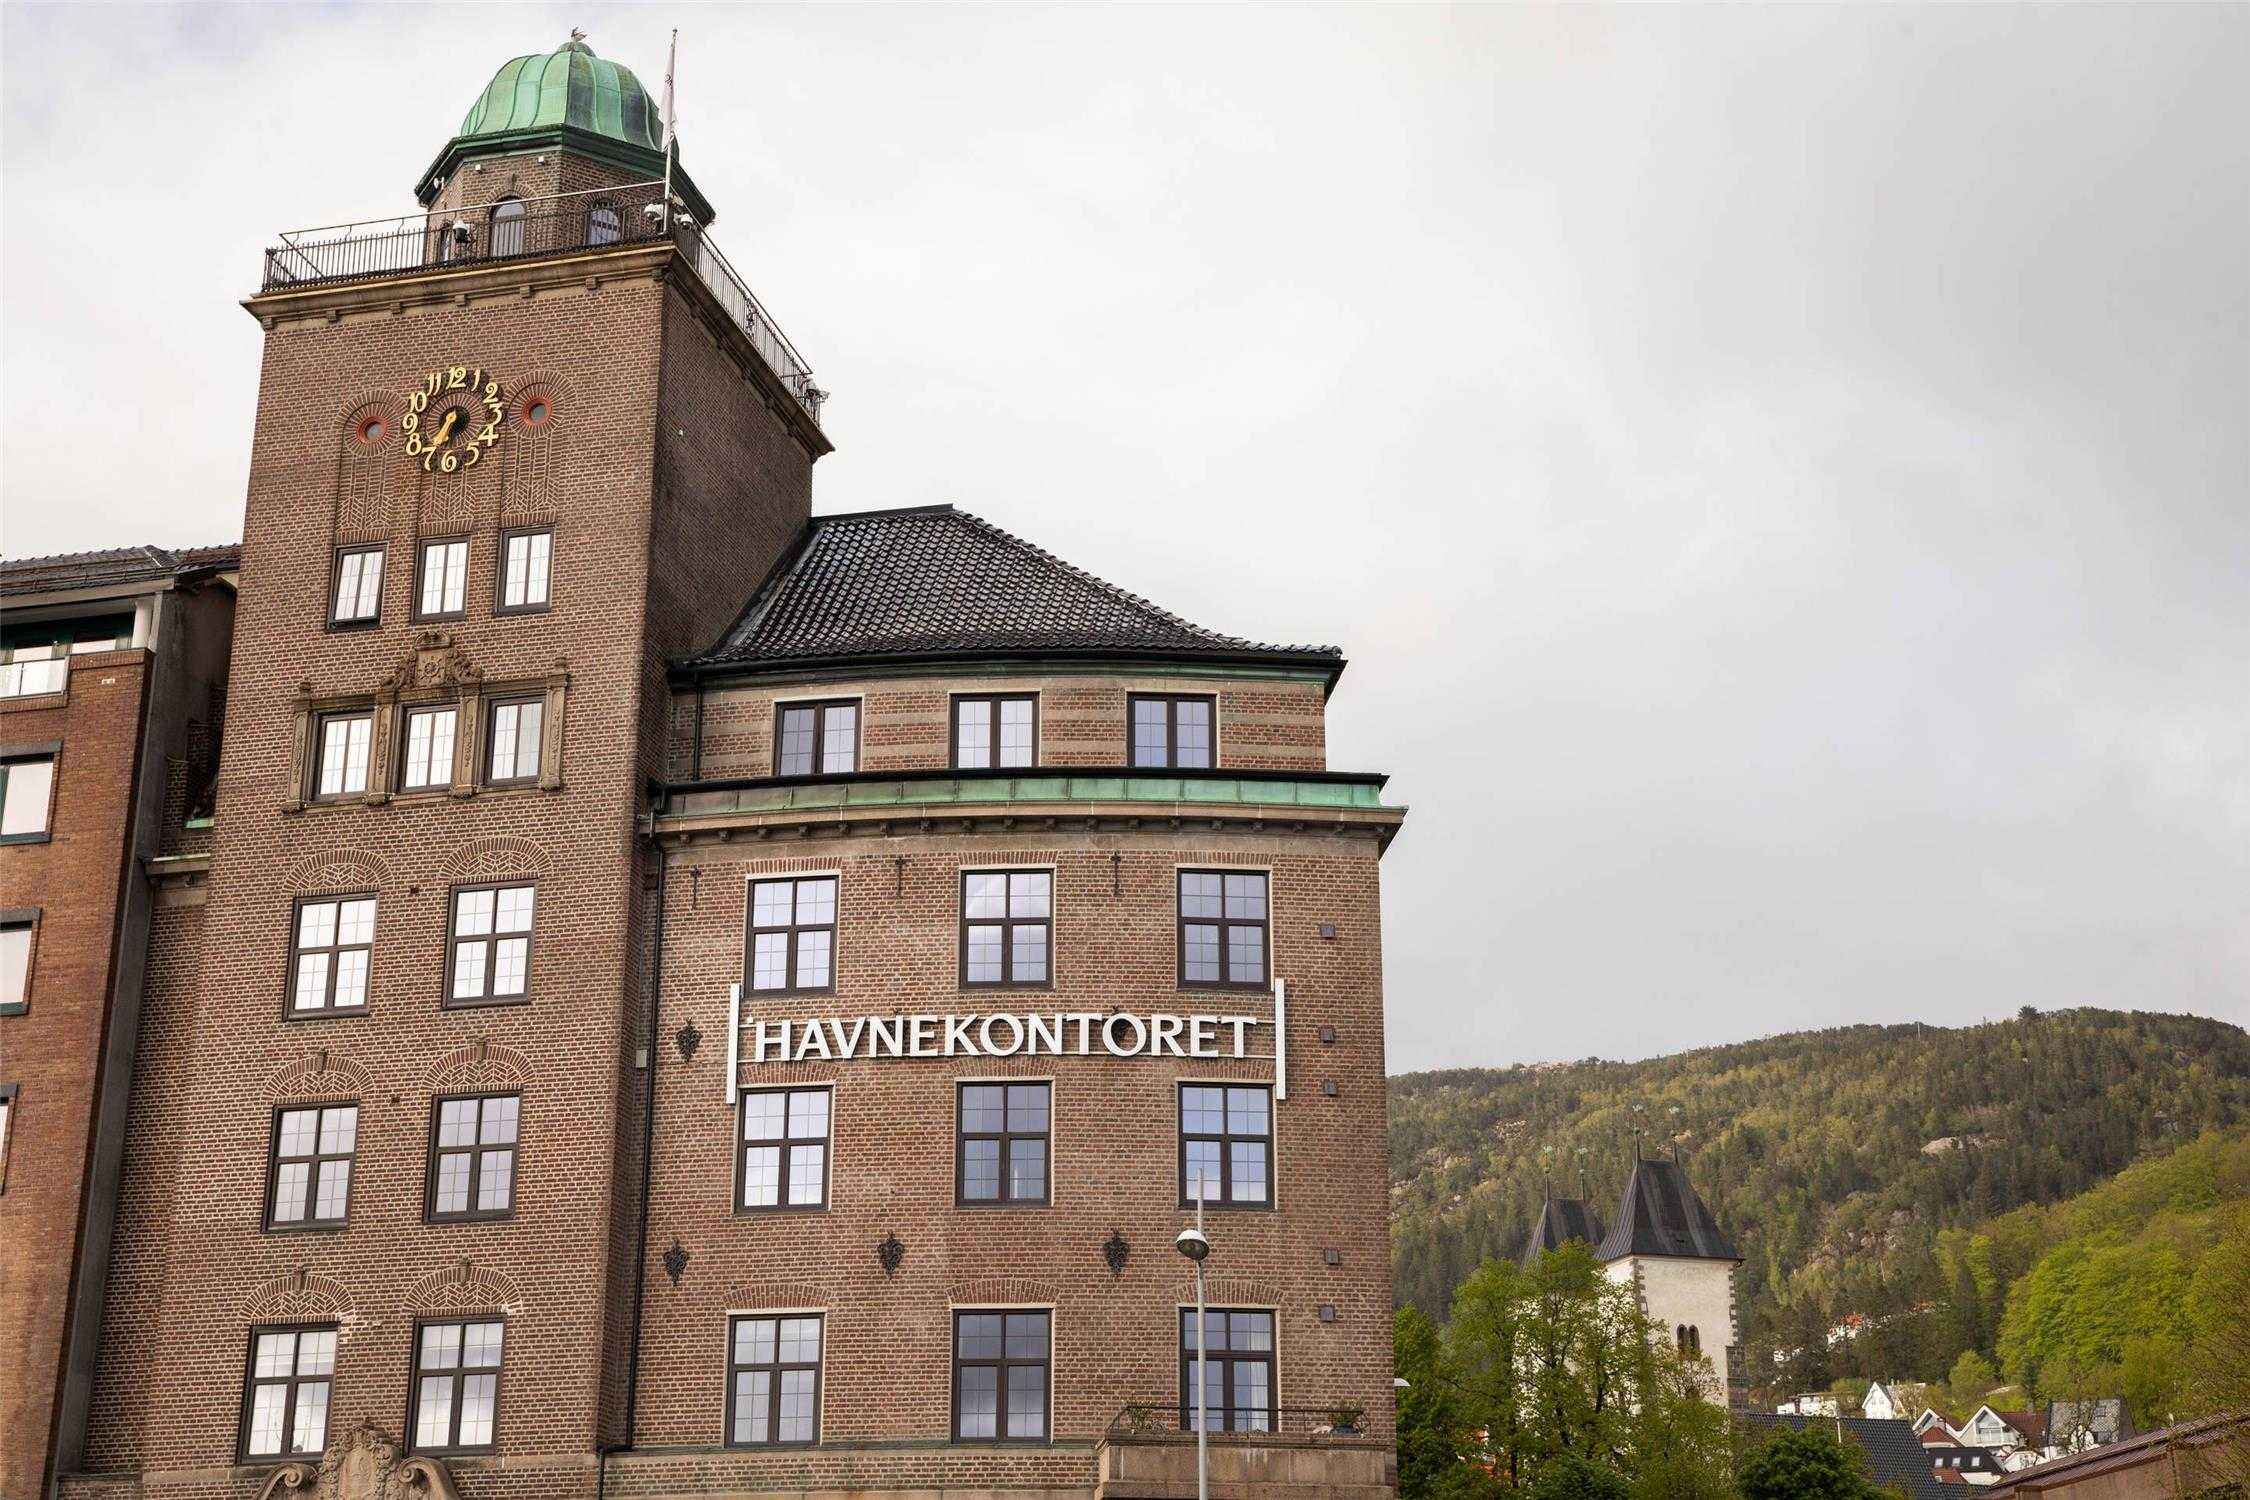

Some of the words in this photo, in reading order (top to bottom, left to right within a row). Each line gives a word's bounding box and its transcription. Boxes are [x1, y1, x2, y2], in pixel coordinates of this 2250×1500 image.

[427, 372, 441, 396] 11
[446, 366, 467, 390] 12
[471, 369, 480, 391] 1
[409, 391, 427, 412] 10
[483, 382, 498, 404] 2
[402, 413, 418, 435] 9
[488, 402, 503, 426] 3
[405, 433, 422, 456] 8
[478, 424, 499, 447] 4
[421, 446, 437, 471] 7
[441, 450, 457, 473] 6
[464, 442, 479, 466] 5
[754, 1012, 1258, 1063] HAVNEKONTORET
